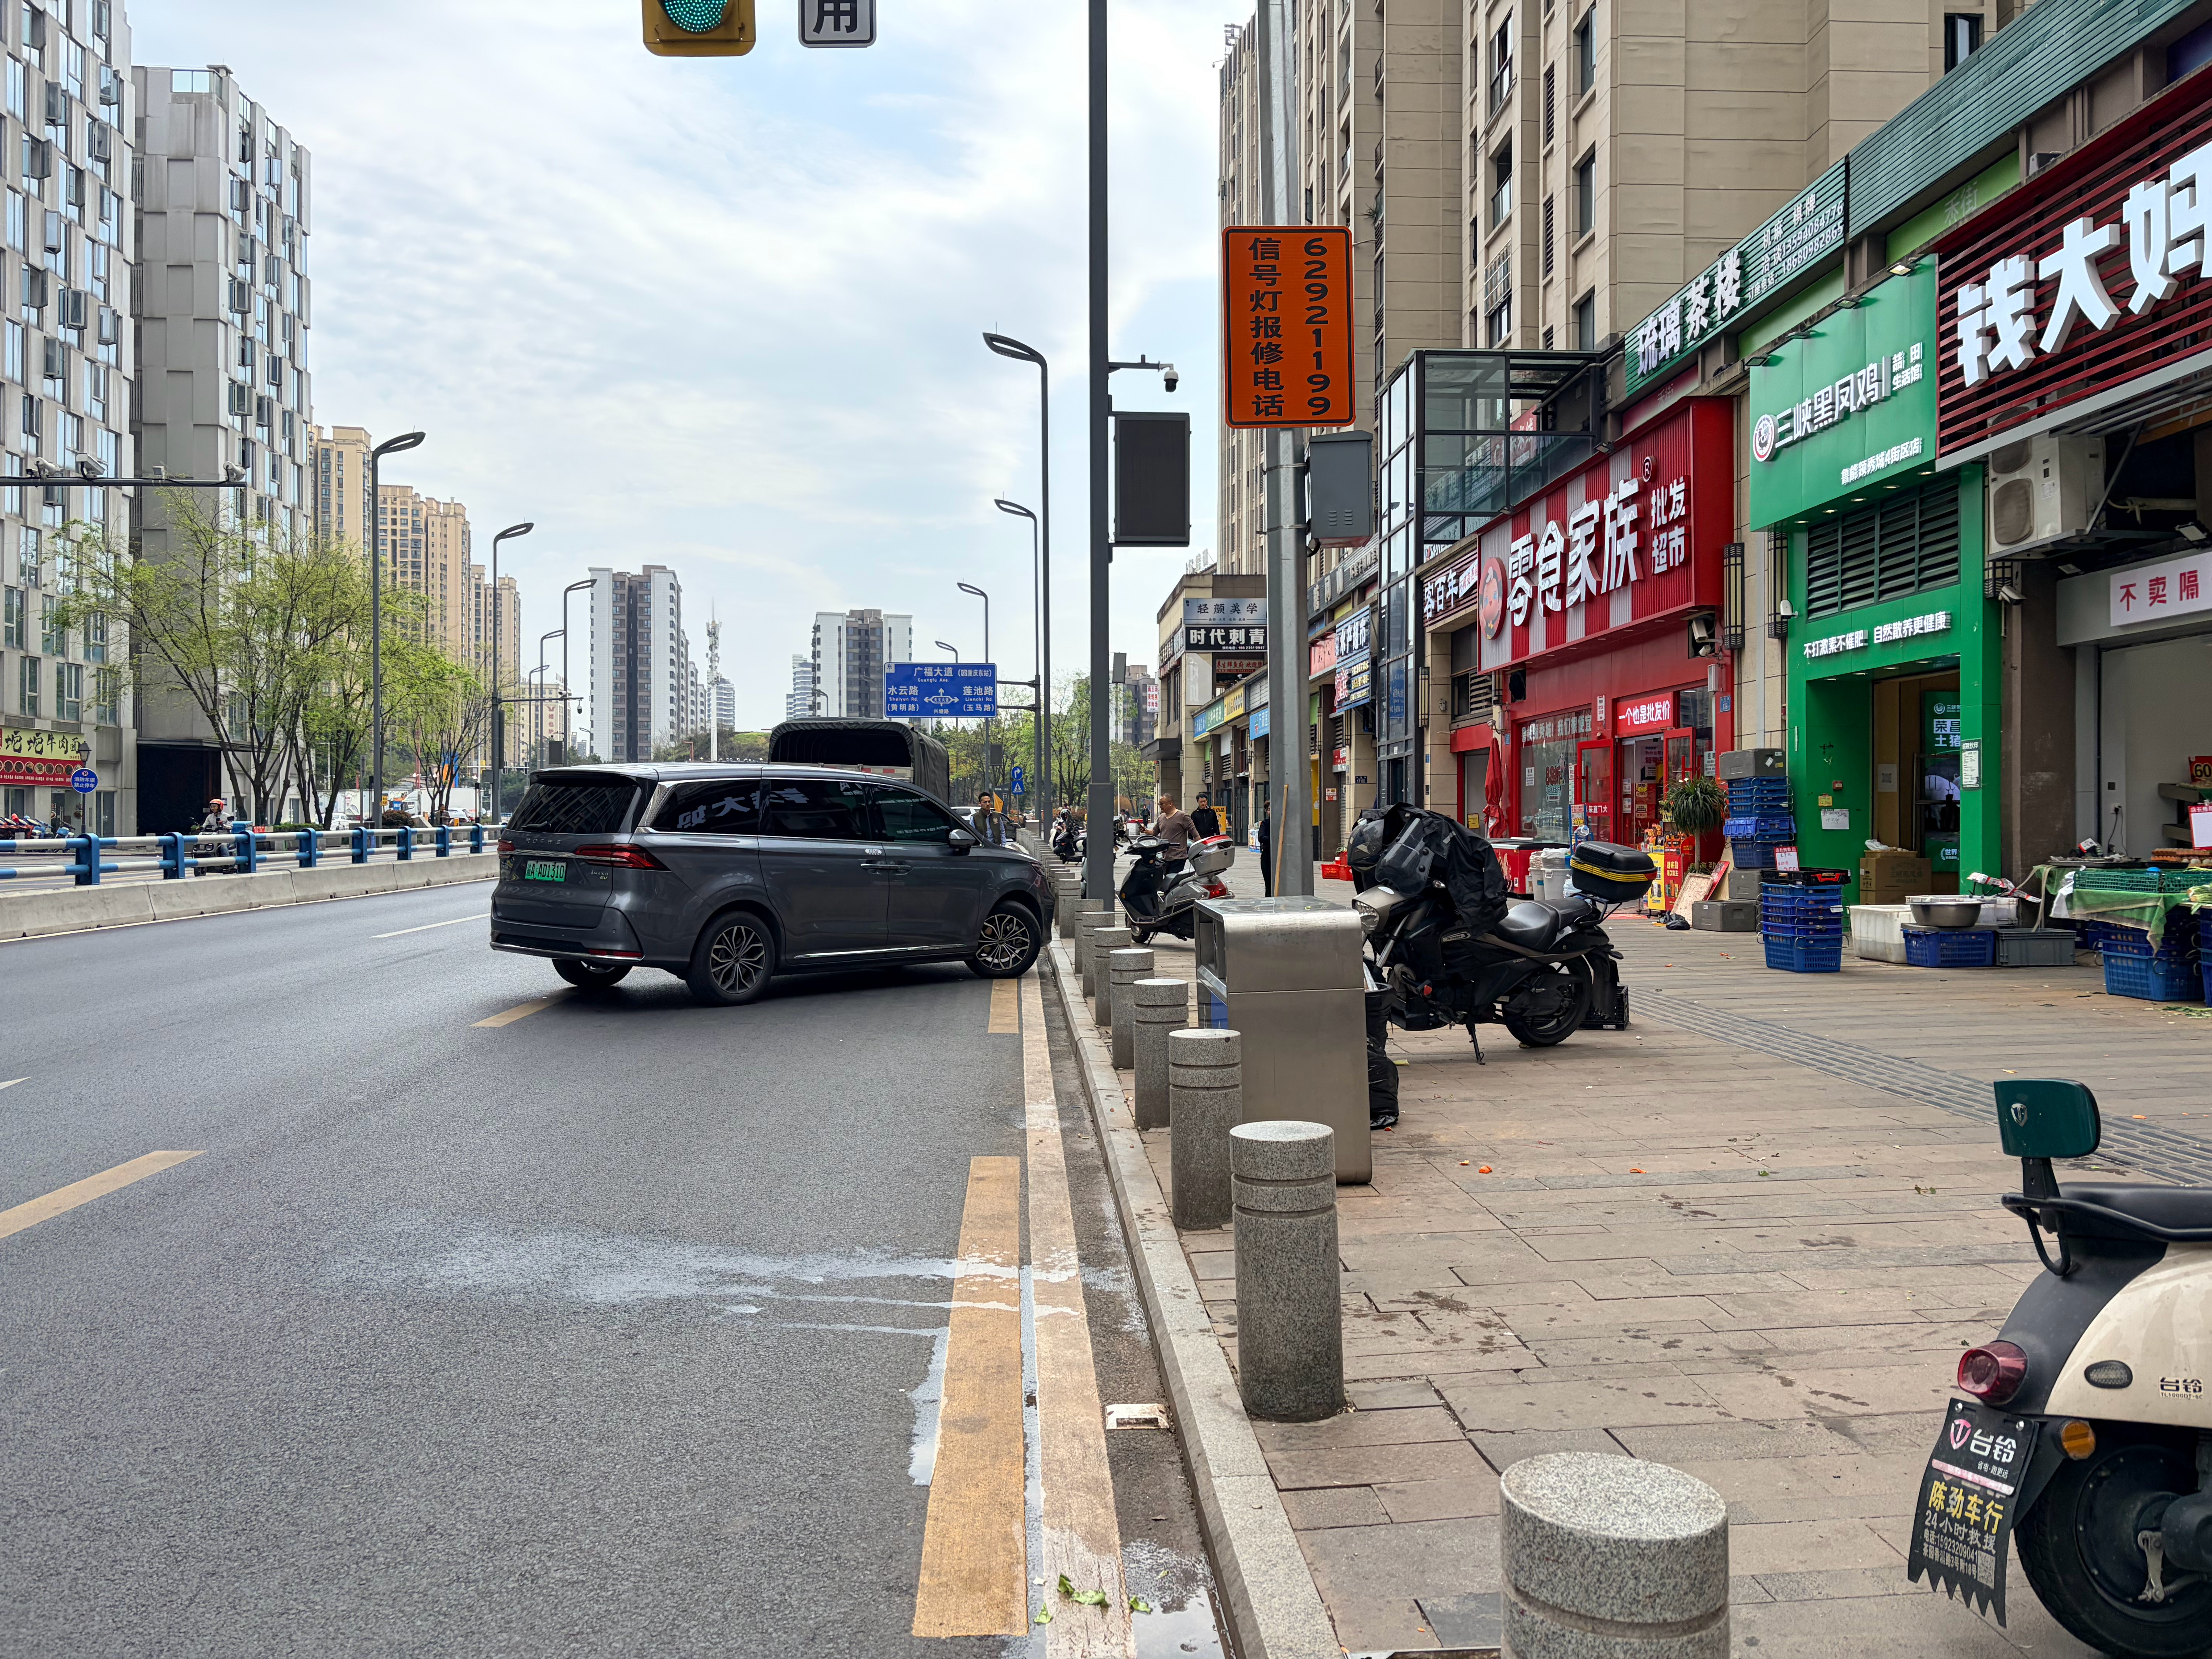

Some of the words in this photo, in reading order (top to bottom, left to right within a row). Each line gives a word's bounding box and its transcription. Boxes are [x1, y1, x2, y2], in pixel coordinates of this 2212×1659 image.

[1762, 220, 1784, 250] 机麻
[1793, 194, 1816, 227] 棋牌
[1782, 220, 1844, 276] 18680982865
[1958, 140, 2212, 388] 钱大妈
[1248, 237, 1285, 417] 信号灯报修电话
[1304, 237, 1331, 416] 62921199
[1637, 250, 1742, 376] 琉璃茶楼
[1892, 363, 1923, 391] 生活馆
[1775, 362, 1879, 448] 三峡黑凤鸡
[1650, 477, 1686, 529] 批发
[1507, 479, 1643, 627] 零食家族
[1651, 526, 1686, 574] 超市
[1197, 603, 1258, 614] 轻颜美学
[1424, 568, 1458, 619] 客百年
[2120, 565, 2212, 611] 不卖隔
[1190, 629, 1265, 645] 时代刺青
[1803, 630, 1865, 658] 不打激素不催肥
[1874, 611, 1947, 644] 自然散养更健康
[888, 685, 919, 696] 水云路
[914, 666, 953, 677] 广福大道
[963, 685, 994, 696] 莲池路
[1618, 699, 1670, 726] 一个也是批发价
[1935, 720, 1961, 732] 荣昌
[5, 730, 81, 755] 坨坨牛肉面
[1935, 734, 1961, 747] 土猪
[2194, 764, 2212, 778] 60
[2160, 1377, 2202, 1393] 台铃
[1970, 1428, 2016, 1463] 台铃
[1928, 1480, 2003, 1534] 陈劲车行
